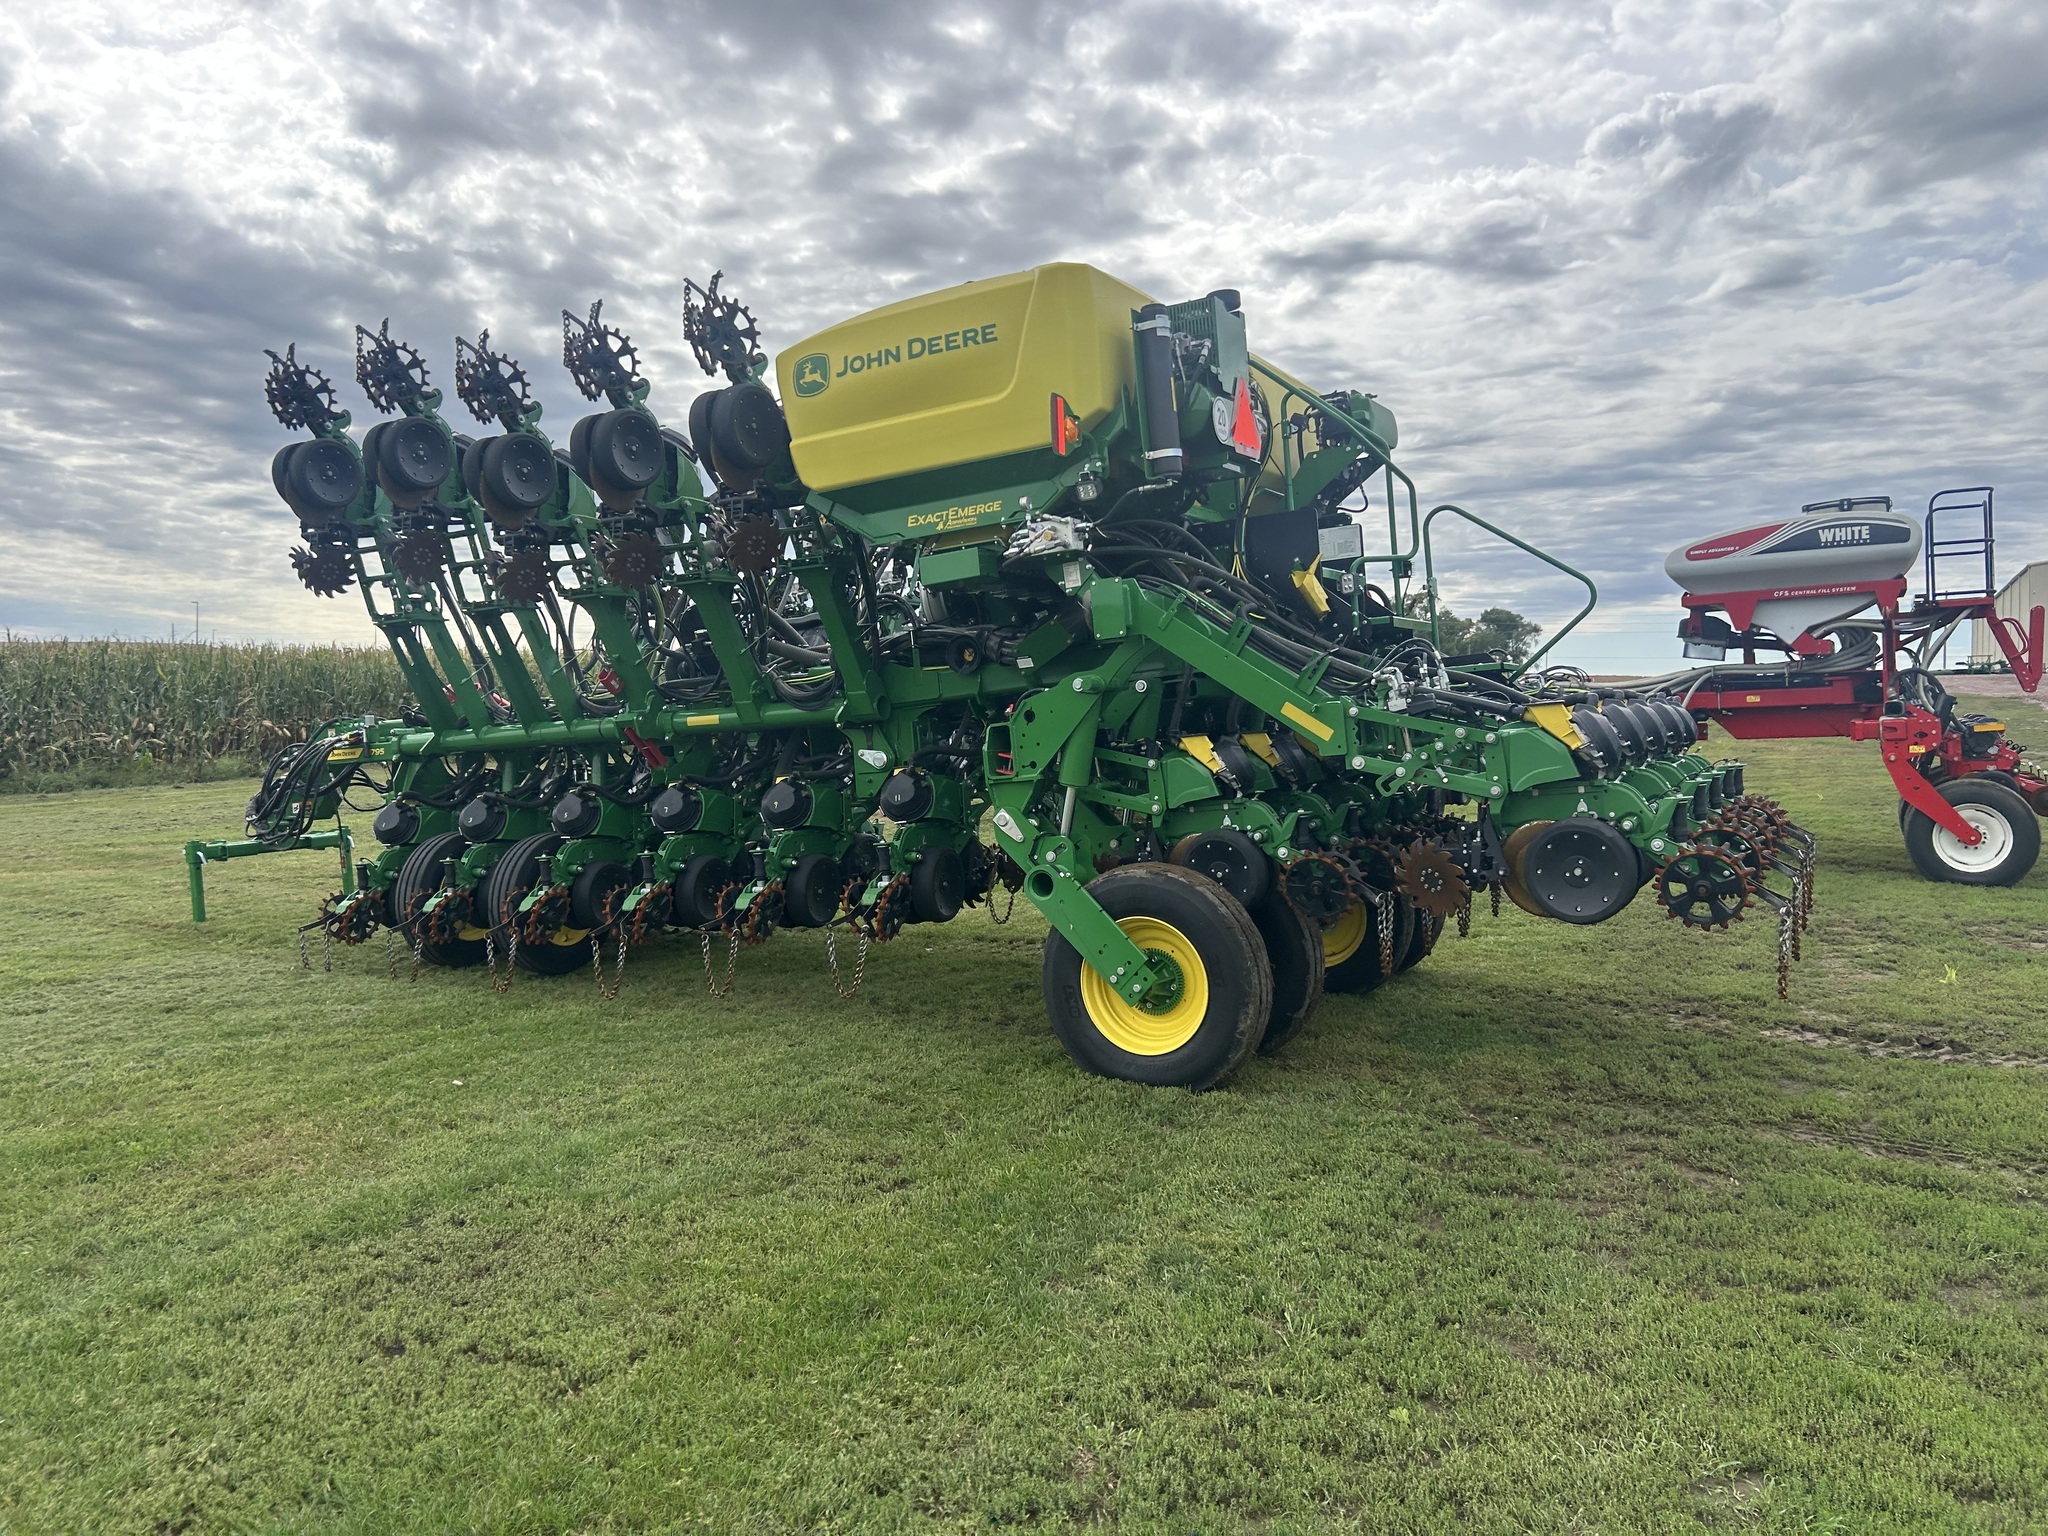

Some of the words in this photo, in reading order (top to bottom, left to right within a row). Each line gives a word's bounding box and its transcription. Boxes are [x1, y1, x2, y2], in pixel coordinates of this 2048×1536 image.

[836, 345, 901, 378] JOHN
[907, 323, 998, 360] DEERE
[1217, 407, 1226, 427] 20
[907, 500, 1002, 527] EXACTEMERGE
[1818, 525, 1870, 542] WHITE
